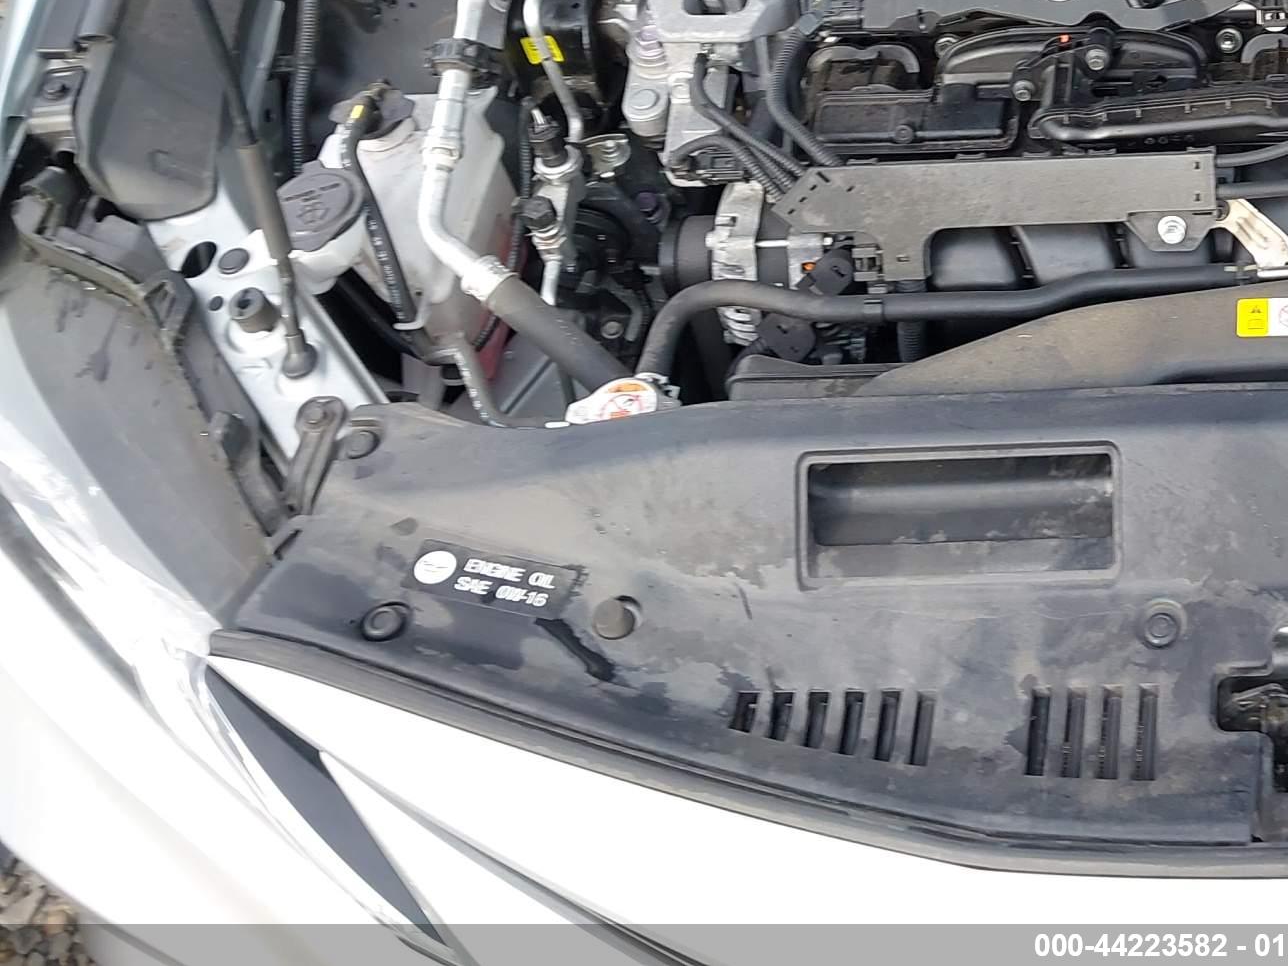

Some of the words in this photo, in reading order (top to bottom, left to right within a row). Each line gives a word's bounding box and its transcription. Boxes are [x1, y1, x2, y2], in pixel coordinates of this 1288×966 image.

[454, 576, 494, 595] SAE
[463, 558, 527, 582] ENGINE
[528, 572, 556, 589] OIL
